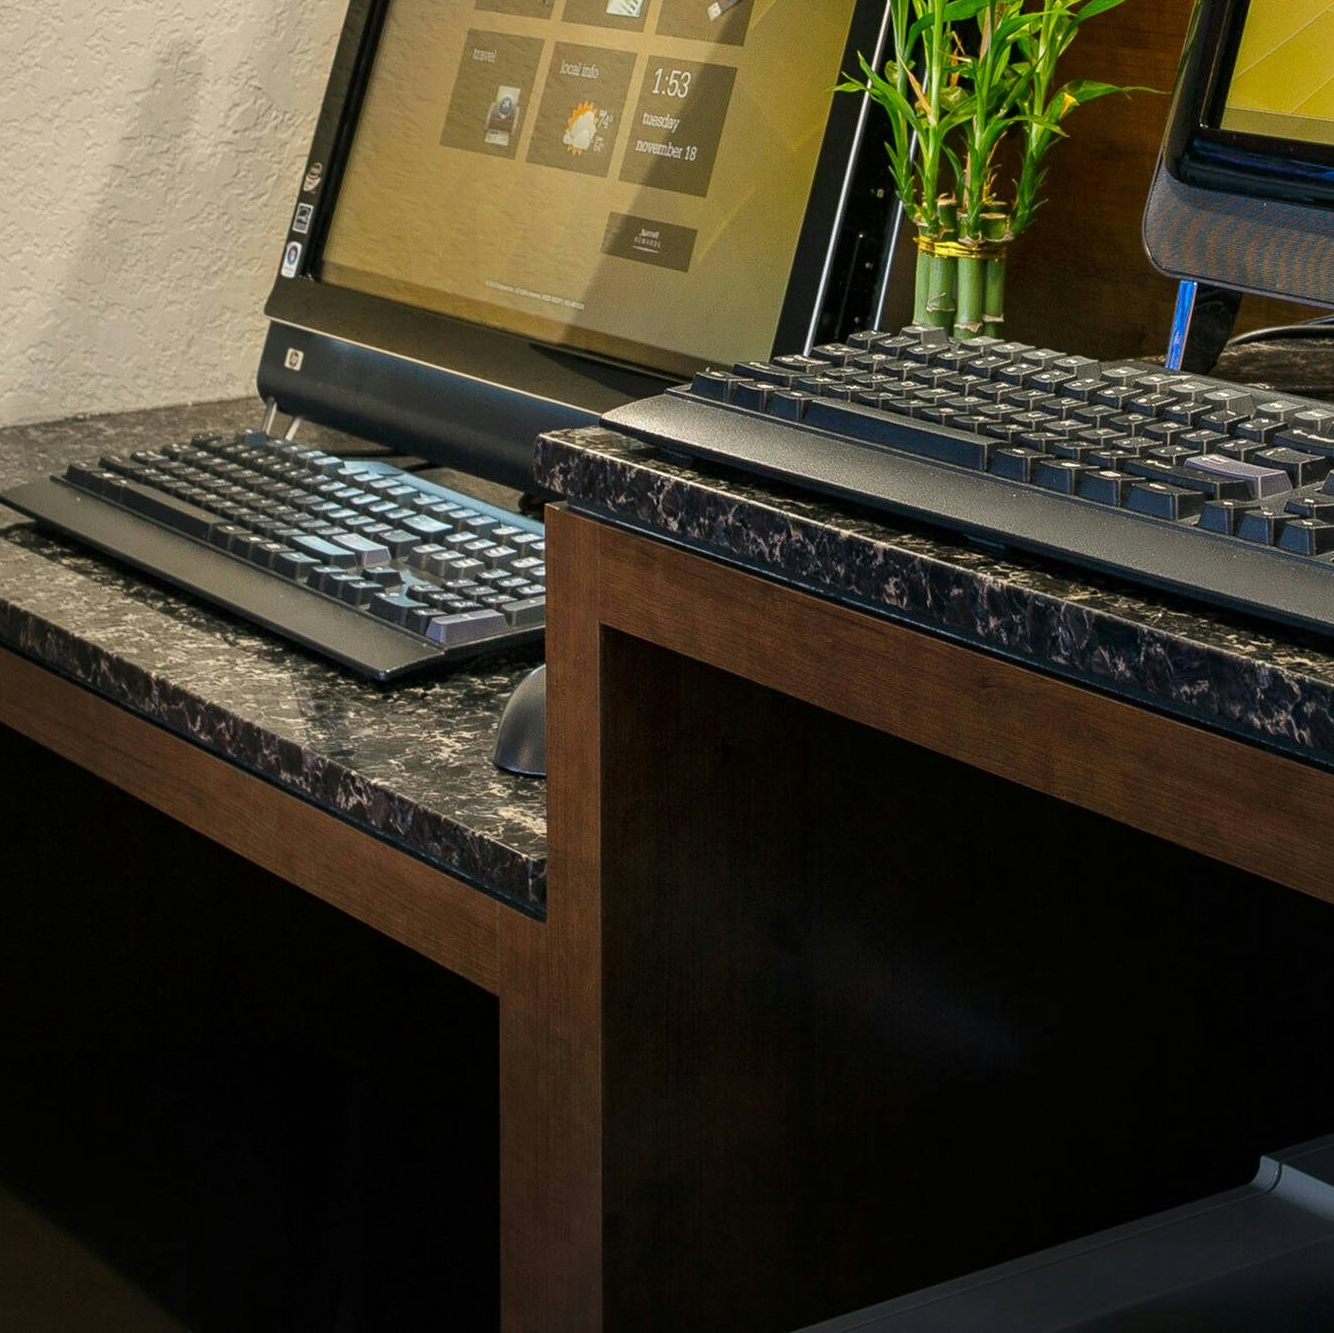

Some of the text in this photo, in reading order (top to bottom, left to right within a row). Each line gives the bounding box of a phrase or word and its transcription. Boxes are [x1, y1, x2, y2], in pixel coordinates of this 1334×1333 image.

[652, 68, 692, 98] 1:53
[642, 112, 681, 133] tuesday
[635, 140, 698, 162] november 18
